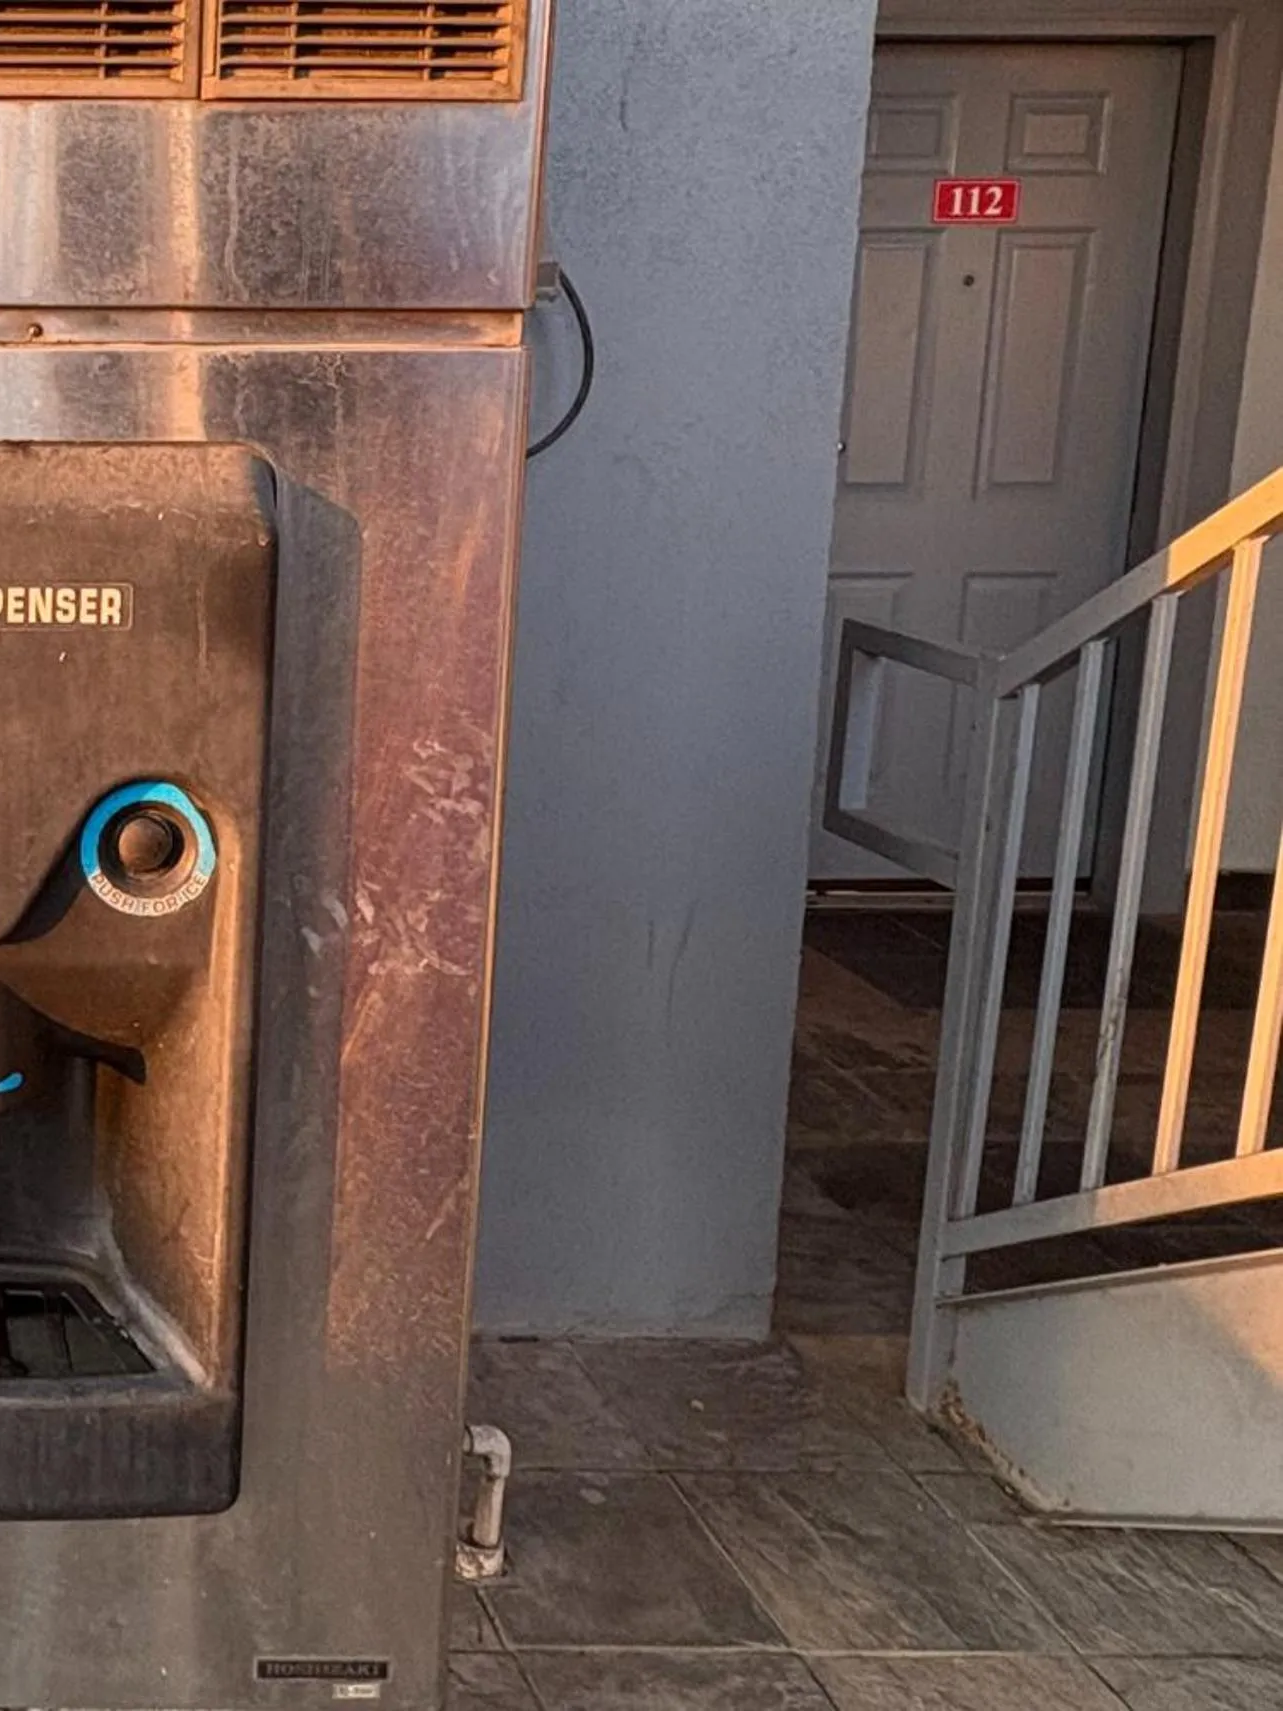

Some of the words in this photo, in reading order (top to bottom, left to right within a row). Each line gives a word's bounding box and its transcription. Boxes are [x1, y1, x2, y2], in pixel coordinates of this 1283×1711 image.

[949, 186, 1003, 216] 112
[92, 874, 134, 910] PUSH
[142, 896, 179, 912] FOR
[181, 873, 206, 902] ICE
